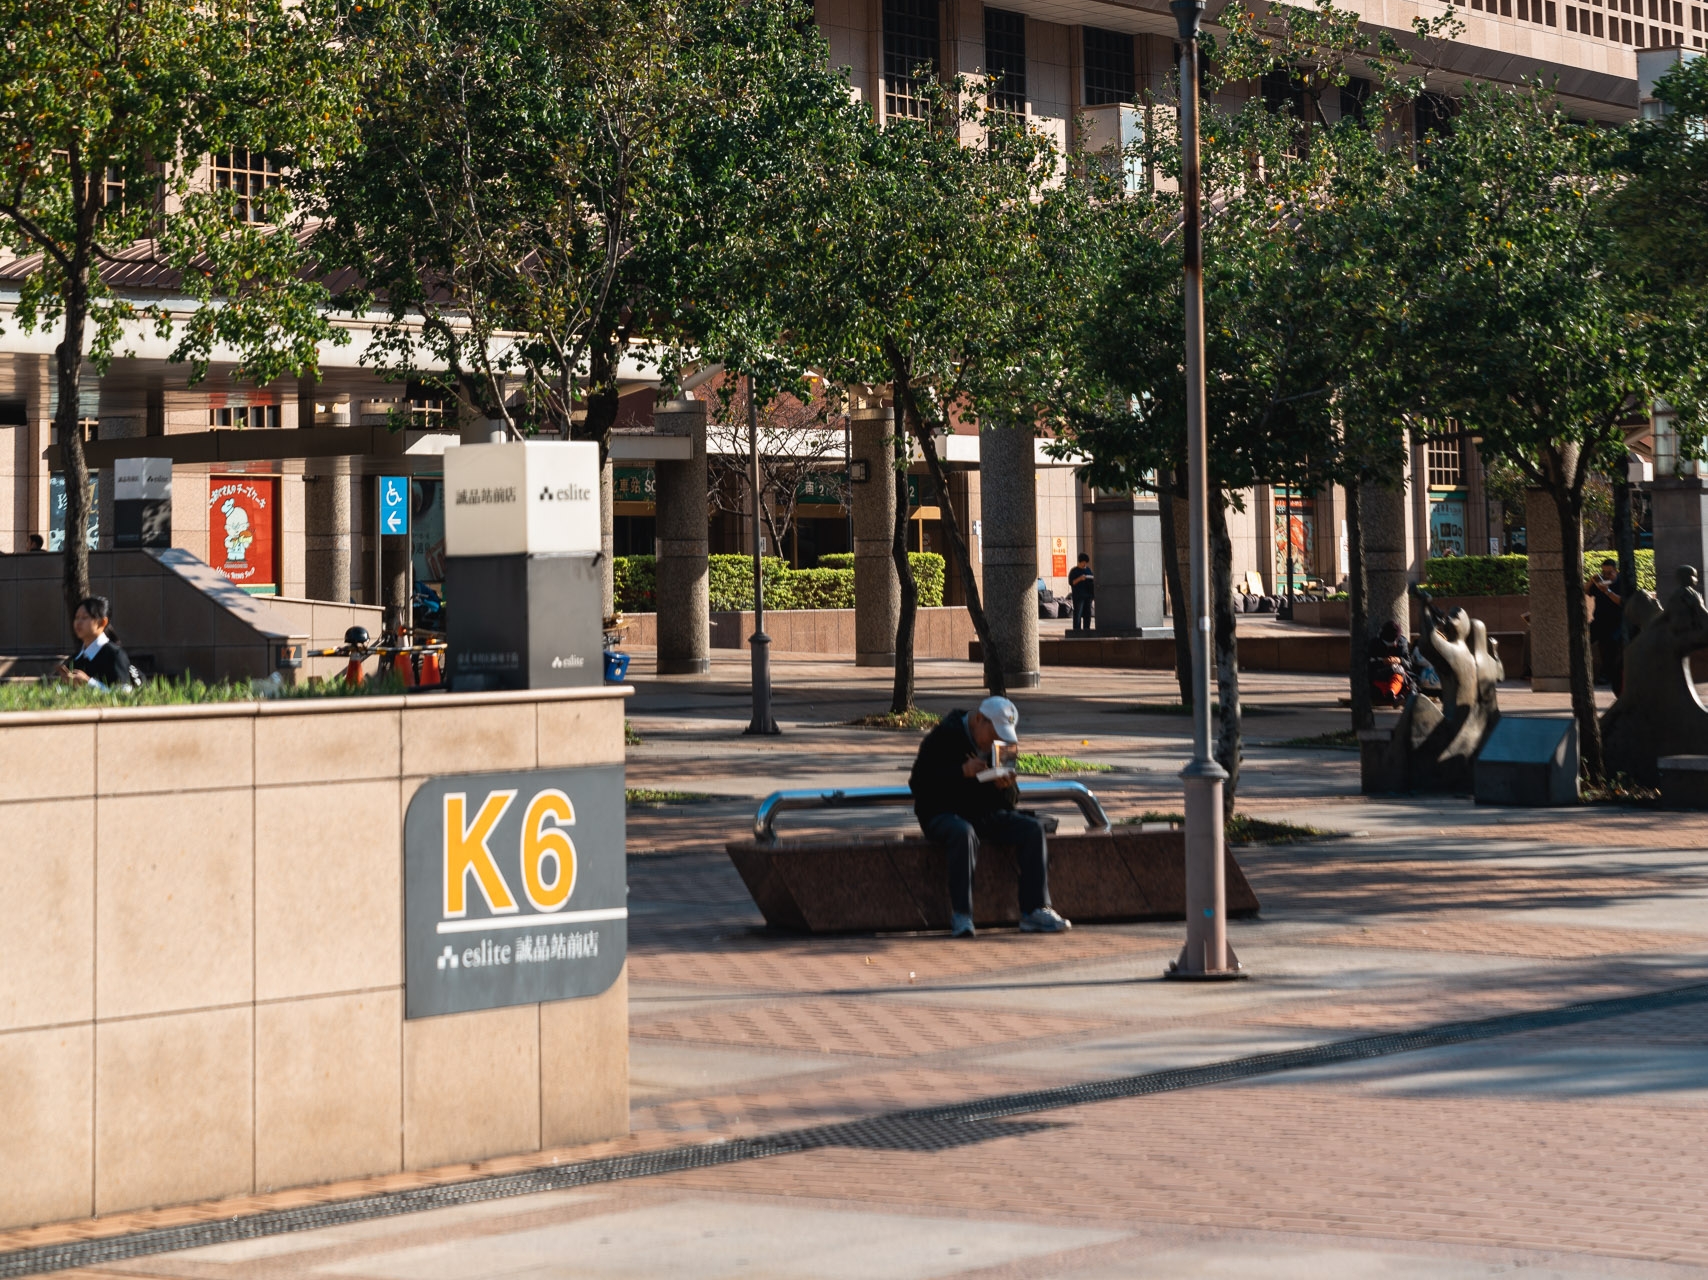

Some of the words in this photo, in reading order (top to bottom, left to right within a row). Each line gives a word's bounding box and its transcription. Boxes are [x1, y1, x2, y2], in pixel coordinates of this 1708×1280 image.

[455, 486, 517, 505] 誠品站前店
[556, 483, 591, 501] eslite
[281, 646, 297, 661] K7
[563, 654, 585, 668] eslite
[443, 788, 578, 919] K6
[461, 938, 512, 968] eslite
[514, 930, 600, 963] 誠品站前店
